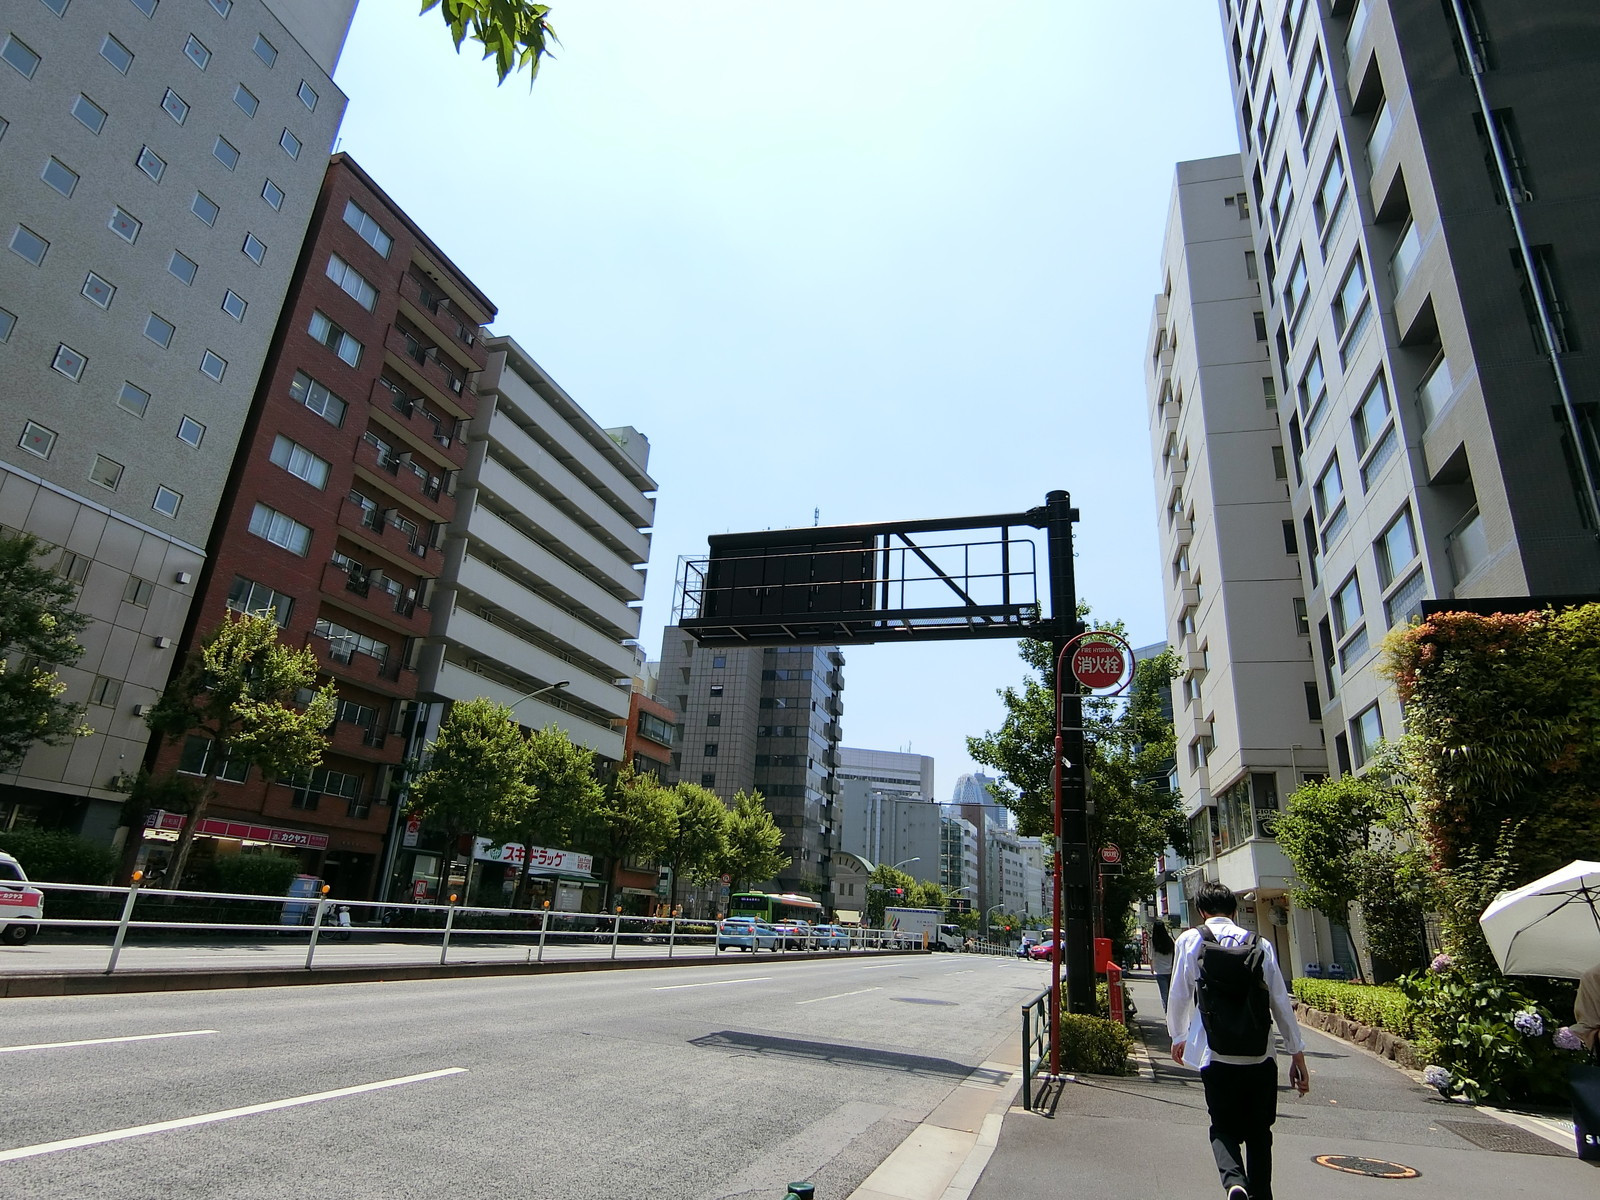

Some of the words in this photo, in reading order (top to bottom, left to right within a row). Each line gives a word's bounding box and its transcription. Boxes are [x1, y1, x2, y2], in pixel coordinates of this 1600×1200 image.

[1077, 655, 1120, 674] 消火栓
[281, 832, 307, 844] カクヤス
[1585, 1134, 1600, 1144] S
